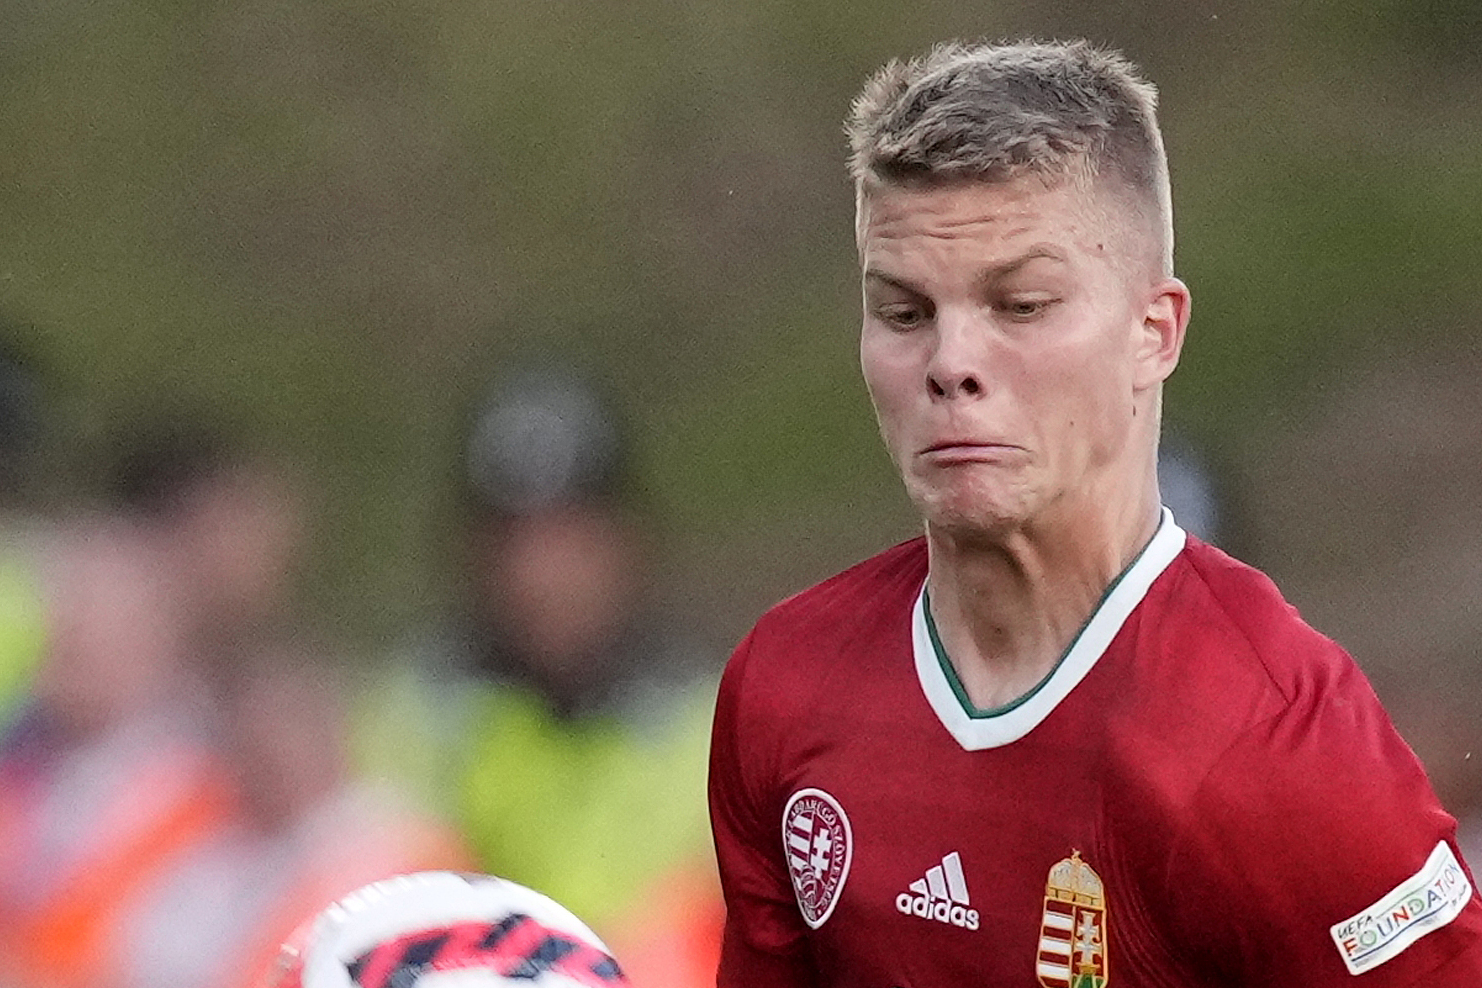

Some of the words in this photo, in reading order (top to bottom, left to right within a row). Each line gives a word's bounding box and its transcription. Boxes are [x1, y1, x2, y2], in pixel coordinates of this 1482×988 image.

[895, 891, 980, 931] adidas
[1337, 914, 1374, 939] UEFA
[1343, 863, 1461, 957] FOUNDATION
